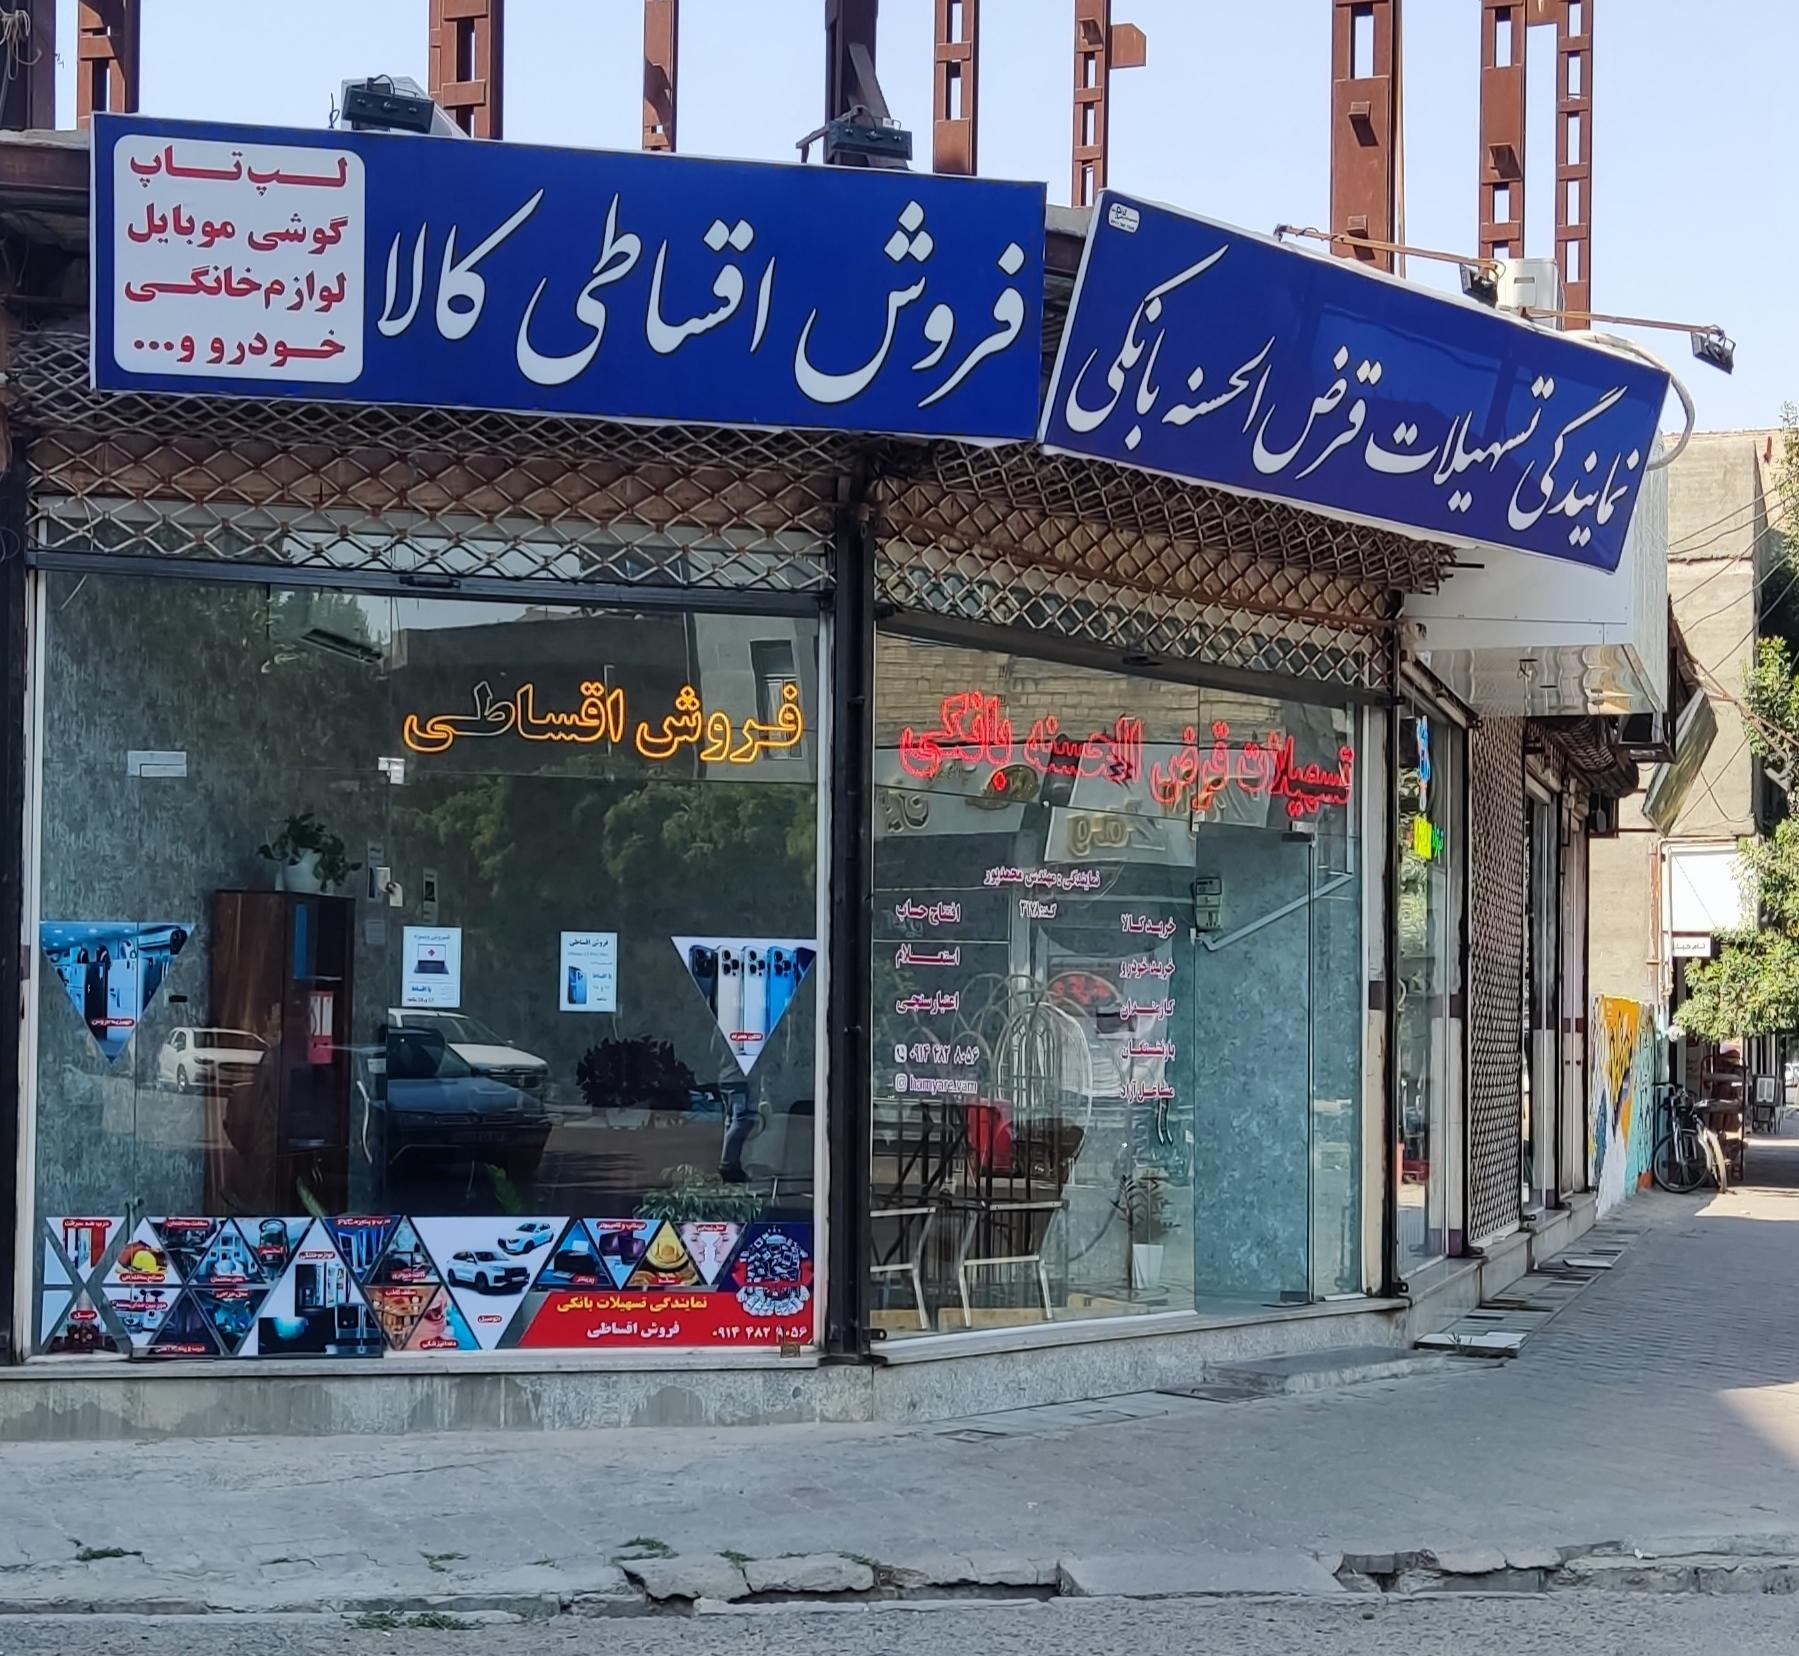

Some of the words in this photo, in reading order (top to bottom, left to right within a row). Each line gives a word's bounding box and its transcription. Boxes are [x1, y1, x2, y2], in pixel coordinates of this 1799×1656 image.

[130, 145, 243, 188] تاپ
[247, 157, 348, 196] لپ
[127, 202, 236, 248] موبایل
[247, 213, 349, 255] گوشی
[124, 265, 262, 302] خانگی
[376, 188, 545, 341] کالا
[263, 271, 347, 312] لوازم
[515, 191, 776, 387] اقساطی
[794, 199, 1026, 410] فروش
[205, 329, 346, 367] خودرو
[1064, 243, 1231, 452] بانکی
[1161, 335, 1276, 434] الحسنه
[1252, 345, 1384, 480] قرض
[1364, 375, 1555, 513] تسهیلات
[1507, 384, 1641, 548] نمایندگی
[403, 679, 626, 754] اقساطی
[634, 683, 805, 764] فروش
[901, 690, 1012, 791] بانکی
[1023, 715, 1143, 783] الحسنه
[1151, 721, 1230, 811] قرض
[1236, 730, 1354, 817] تسهیلات
[896, 898, 928, 921] حساب
[929, 902, 960, 925] افتتاح
[1121, 913, 1146, 933] کالا
[1145, 916, 1176, 939] خرید
[896, 943, 960, 969] استعلام
[1120, 956, 1149, 979] خودرو
[1149, 957, 1175, 980] خرید
[1120, 997, 1175, 1020] کارمندان
[1121, 1038, 1175, 1062] بازنشستگان
[1120, 1080, 1138, 1104] آزاد
[1137, 1080, 1175, 1103] مشاغل
[556, 1296, 593, 1313] بانکی
[596, 1296, 647, 1311] تسهیلات
[650, 1296, 708, 1313] نمایندگی
[587, 1321, 639, 1339] اقساطی
[640, 1321, 680, 1339] فروش
[712, 1325, 740, 1339] ۰۹۱۴
